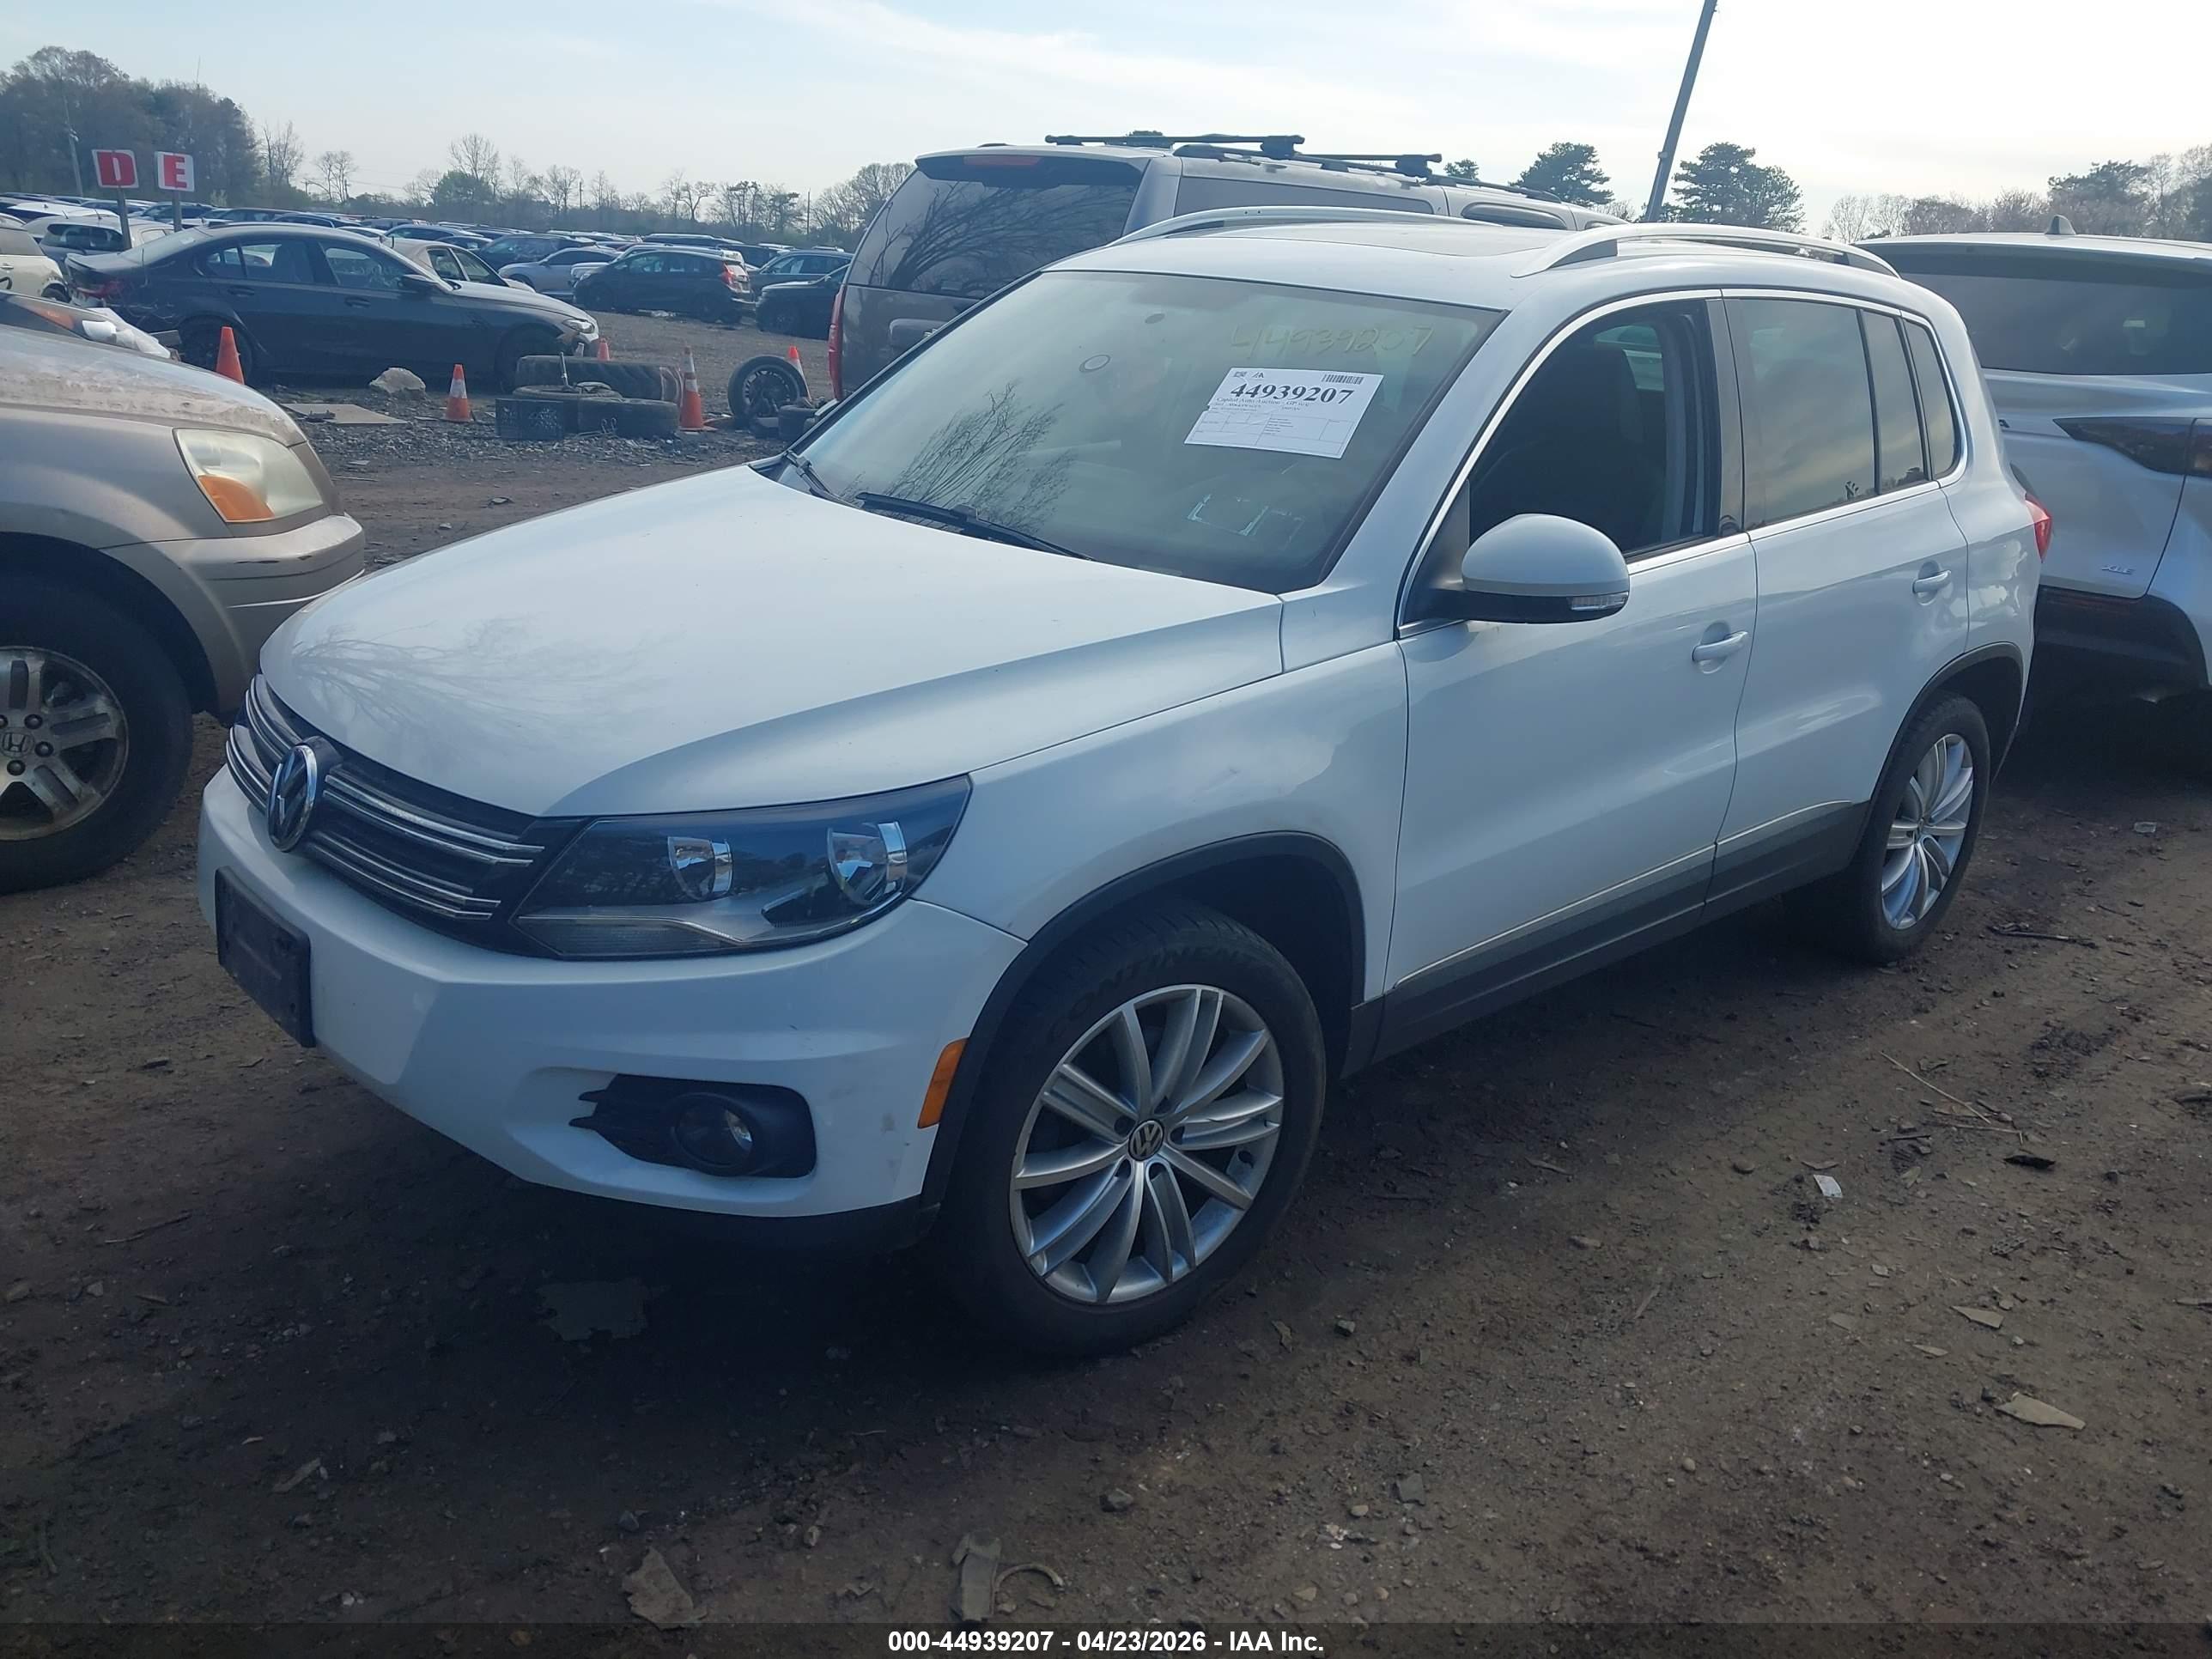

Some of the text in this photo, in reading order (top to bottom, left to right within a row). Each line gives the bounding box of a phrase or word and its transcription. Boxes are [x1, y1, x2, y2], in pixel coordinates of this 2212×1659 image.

[96, 150, 137, 186] D
[162, 154, 187, 188] E
[1231, 322, 1434, 360] 44939207
[1231, 383, 1355, 405] 44939207
